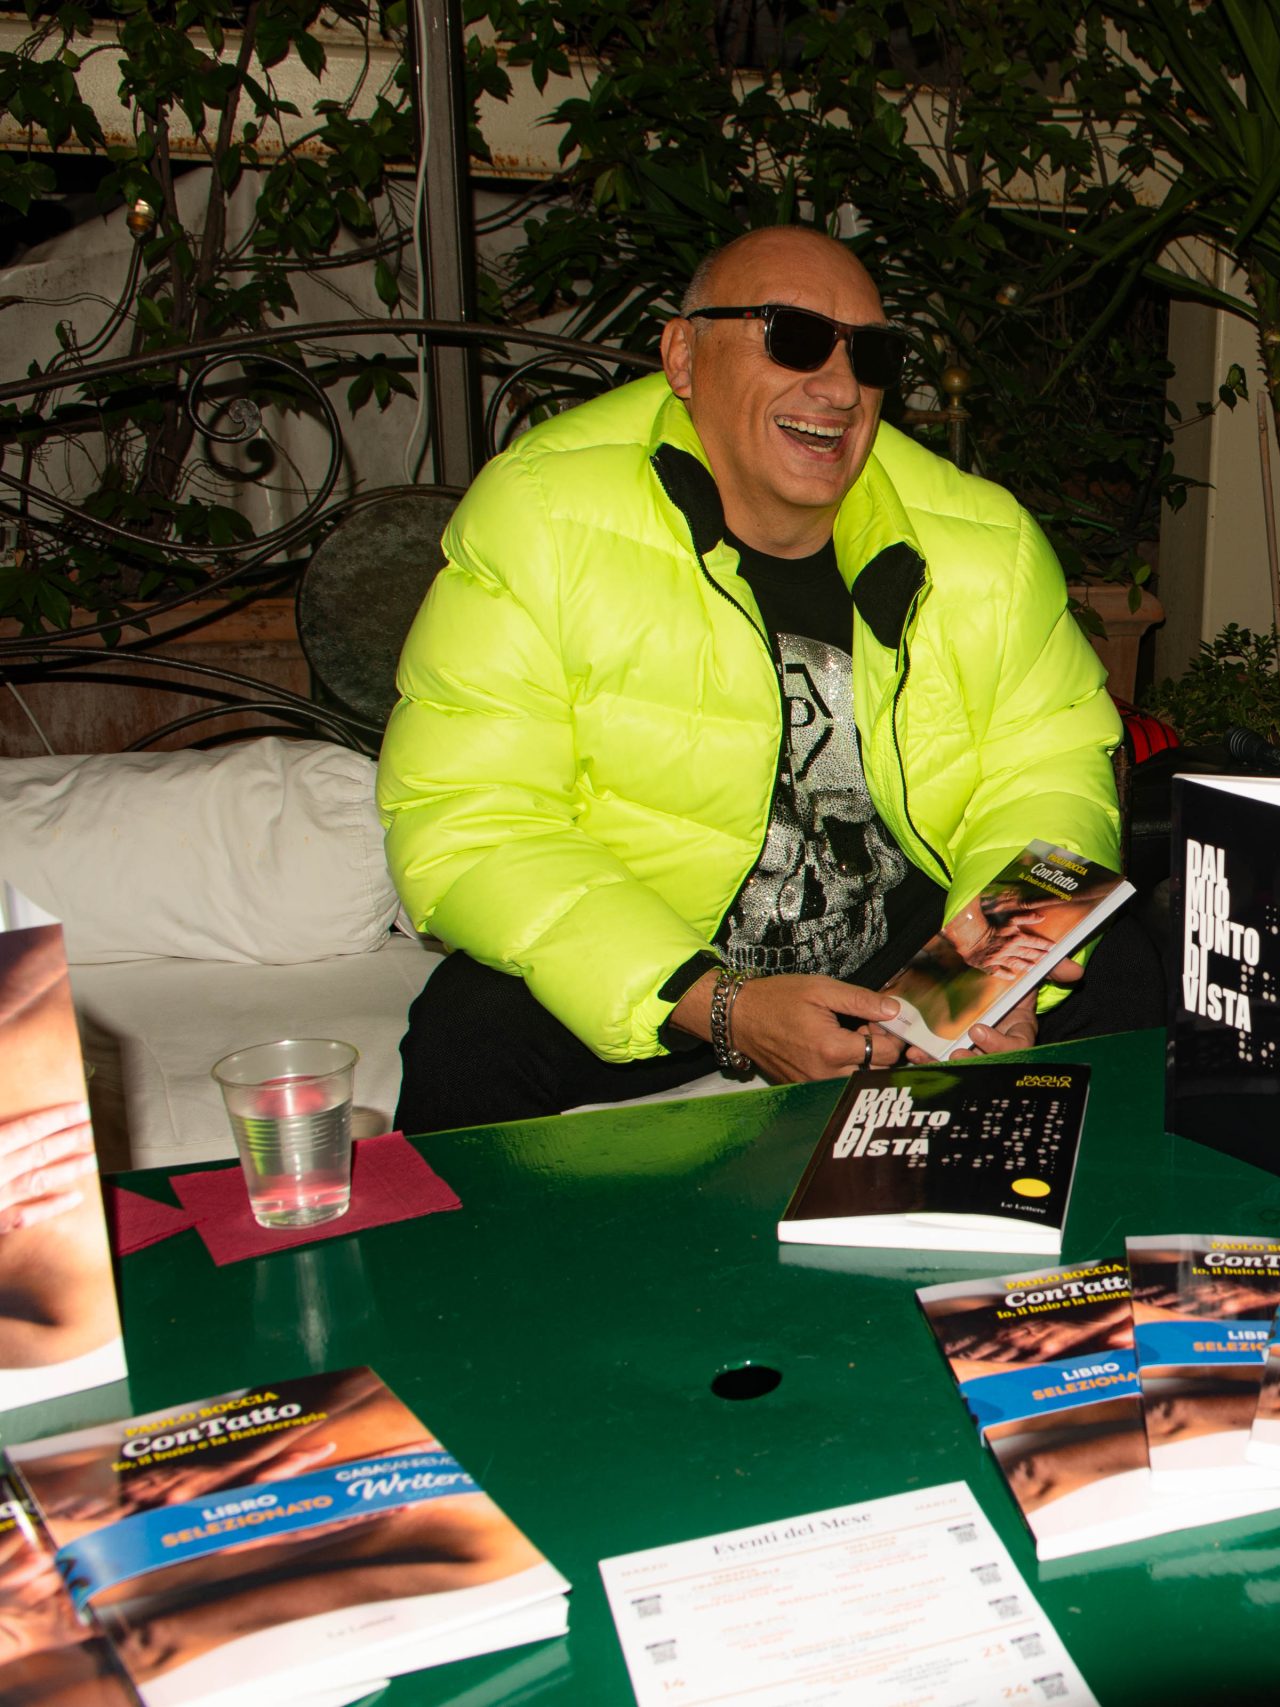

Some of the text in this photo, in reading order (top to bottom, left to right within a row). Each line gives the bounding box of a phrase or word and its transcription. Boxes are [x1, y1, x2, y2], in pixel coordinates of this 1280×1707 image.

[1031, 862, 1078, 891] ConTatto
[1186, 838, 1228, 887] DAL
[1185, 876, 1230, 921] MIO
[1184, 909, 1260, 967] PUNTO
[1183, 942, 1208, 979] DI
[1182, 973, 1252, 1033] VISTA
[1015, 1080, 1072, 1088] BOCCIA
[1023, 1075, 1072, 1083] PAOLO
[852, 1099, 914, 1114] MIO
[856, 1086, 913, 1101] DAL
[846, 1110, 951, 1129] PUNTO
[832, 1138, 929, 1159] VISTA
[837, 1126, 875, 1143] DI
[1211, 1241, 1264, 1251] PAOLO
[1005, 1264, 1124, 1290] PAOLO BOCCIA
[1224, 1266, 1255, 1275] buio
[1267, 1268, 1280, 1276] la
[1016, 1307, 1028, 1316] il
[1028, 1302, 1060, 1314] buio
[1072, 1297, 1085, 1306] la
[1062, 1362, 1119, 1381] LIBRO
[124, 1391, 279, 1437] PAOLO BOCCIA
[122, 1403, 302, 1457] ConTatto
[153, 1444, 196, 1461] buio
[197, 1441, 209, 1449] e
[209, 1435, 228, 1447] la
[229, 1412, 328, 1442] fisioterapia
[346, 1472, 475, 1500] Writers
[161, 1495, 334, 1548] SELEZIONATO
[202, 1493, 278, 1522] LIBRO
[712, 1531, 778, 1555] Eventi
[784, 1523, 815, 1540] del
[820, 1512, 872, 1532] Mese
